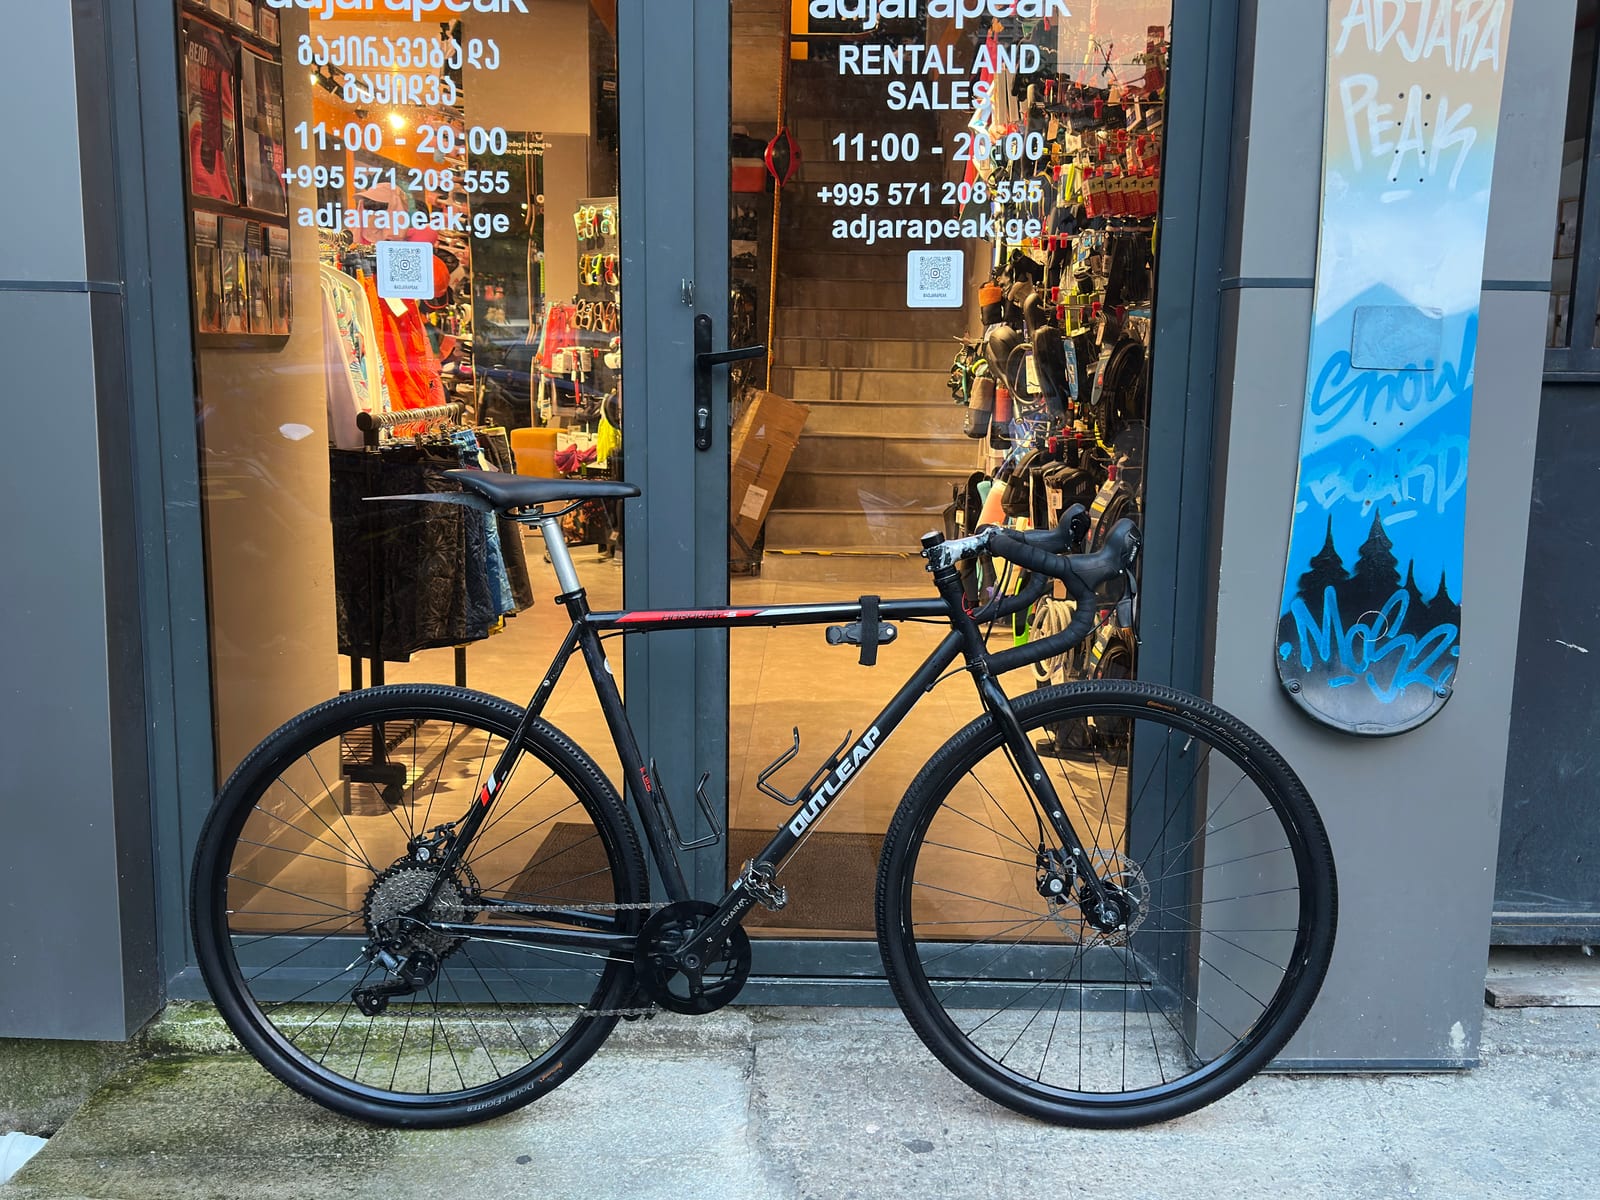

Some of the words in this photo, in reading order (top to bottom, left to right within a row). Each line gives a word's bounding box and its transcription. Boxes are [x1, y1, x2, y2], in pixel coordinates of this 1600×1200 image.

[839, 44, 965, 76] RENTAL
[971, 44, 1041, 75] AND
[343, 72, 457, 106] გაყიდვა
[886, 81, 993, 110] SALES
[294, 121, 383, 152] 11:00
[394, 136, 407, 146] -
[416, 124, 508, 157] 20:00
[832, 132, 920, 162] 11:00
[931, 145, 944, 155] -
[952, 132, 1045, 161] 20:00
[1339, 73, 1477, 190] PEAK
[281, 164, 345, 190] +995
[353, 166, 398, 190] 571
[407, 168, 455, 193] 208
[463, 171, 511, 195] 555
[816, 182, 880, 207] +995
[887, 182, 931, 205] 571
[941, 182, 987, 205] 208
[997, 180, 1042, 204] 555
[297, 202, 511, 239] adjarapeak.ge
[831, 213, 1042, 245] adjarapeak.ge
[788, 725, 881, 838] OUTLEAP
